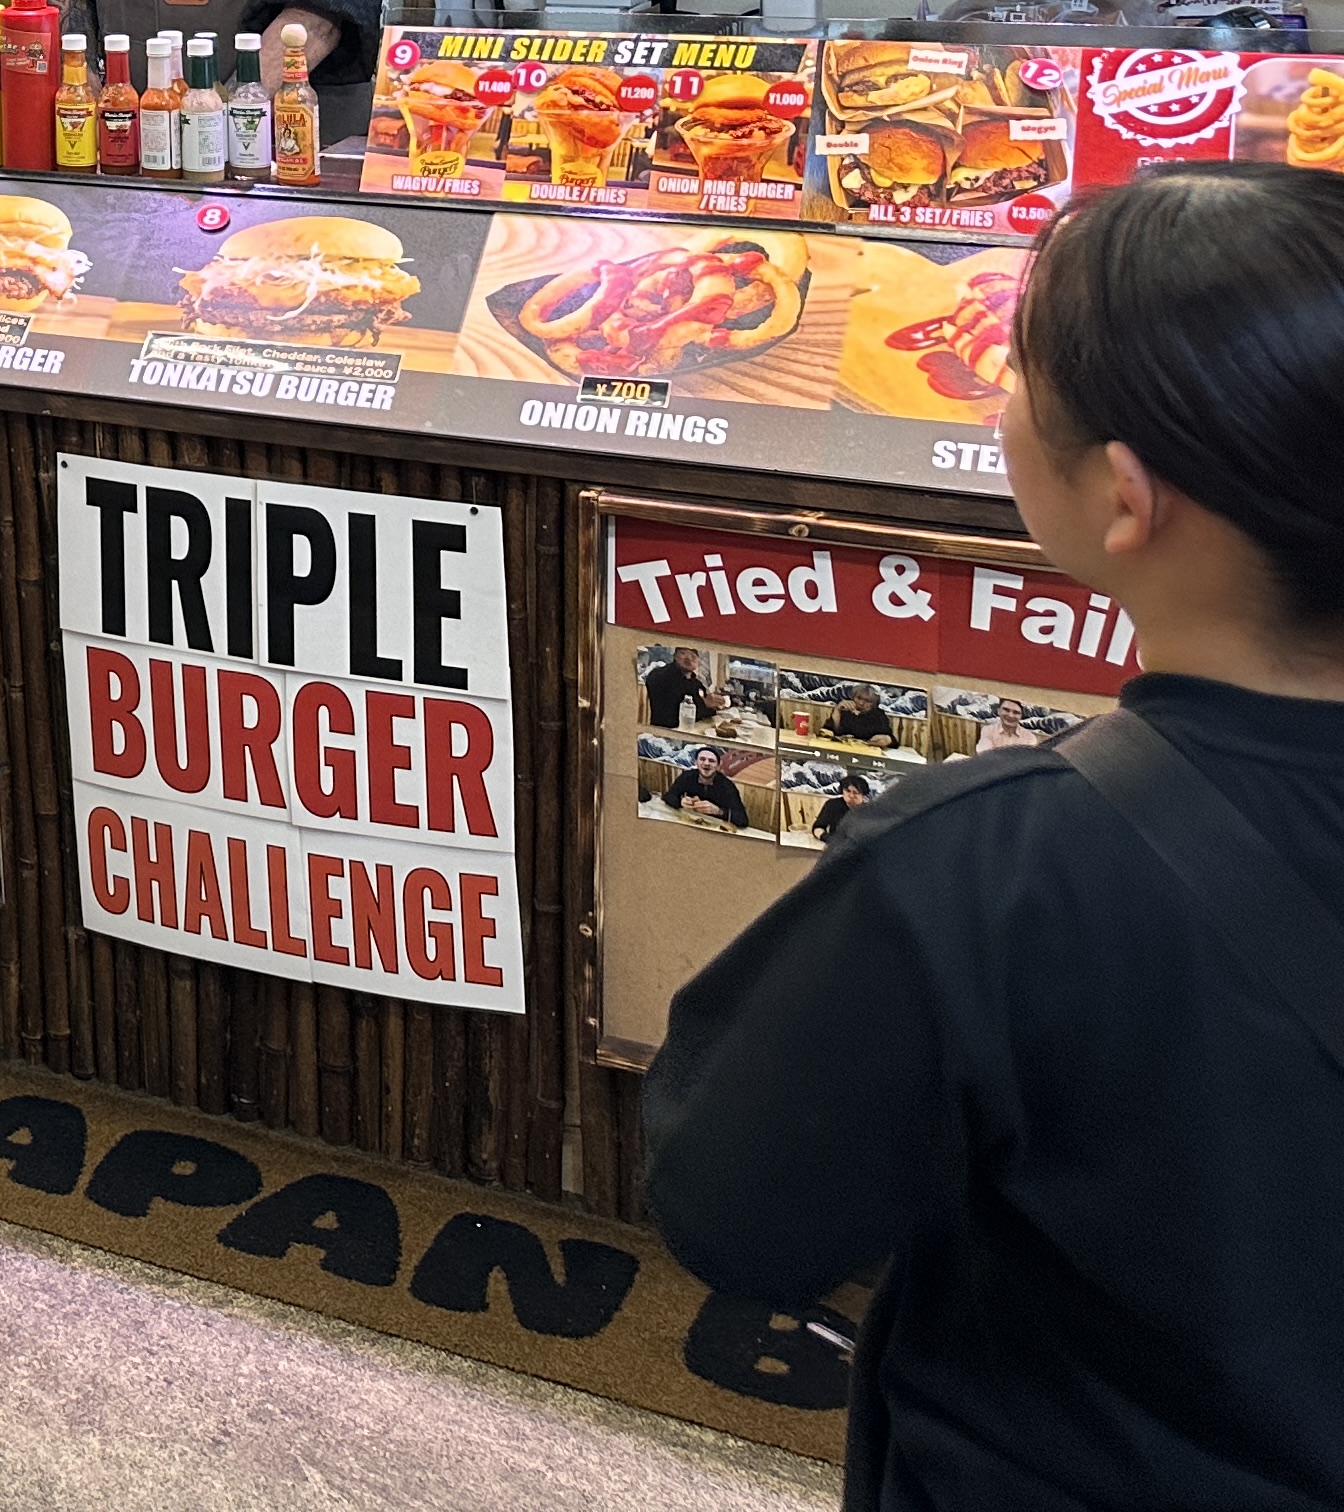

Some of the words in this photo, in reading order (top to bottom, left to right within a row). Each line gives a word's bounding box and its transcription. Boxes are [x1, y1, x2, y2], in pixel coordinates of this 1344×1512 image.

[395, 46, 412, 65] 9
[438, 35, 503, 58] MINI
[511, 37, 607, 63] SLIDER
[614, 41, 668, 65] SET
[672, 44, 757, 68] MENU
[516, 68, 547, 87] 10
[671, 75, 701, 95] 11
[1024, 63, 1060, 86] 12
[1102, 74, 1164, 108] Special
[1173, 63, 1230, 90] Menu
[768, 92, 804, 106] ¥1,000
[392, 175, 480, 196] WAGYU/FRIES
[531, 182, 626, 205] DOUBLE/FRIES
[658, 179, 700, 195] ONION
[703, 180, 735, 197] RING
[739, 182, 794, 200] BURGER
[700, 195, 747, 213] /FRIES
[868, 204, 897, 222] ALL
[915, 206, 994, 228] SET/FRIES
[128, 359, 274, 397] TONKATSU
[276, 375, 396, 410] BURGER
[520, 398, 621, 434] ONION
[629, 408, 729, 446] RINGS
[85, 476, 469, 691] TRIPLE
[616, 550, 838, 625] Tried
[871, 554, 936, 621] &
[86, 646, 499, 838] BURGER
[87, 806, 504, 988] CHALLENGE
